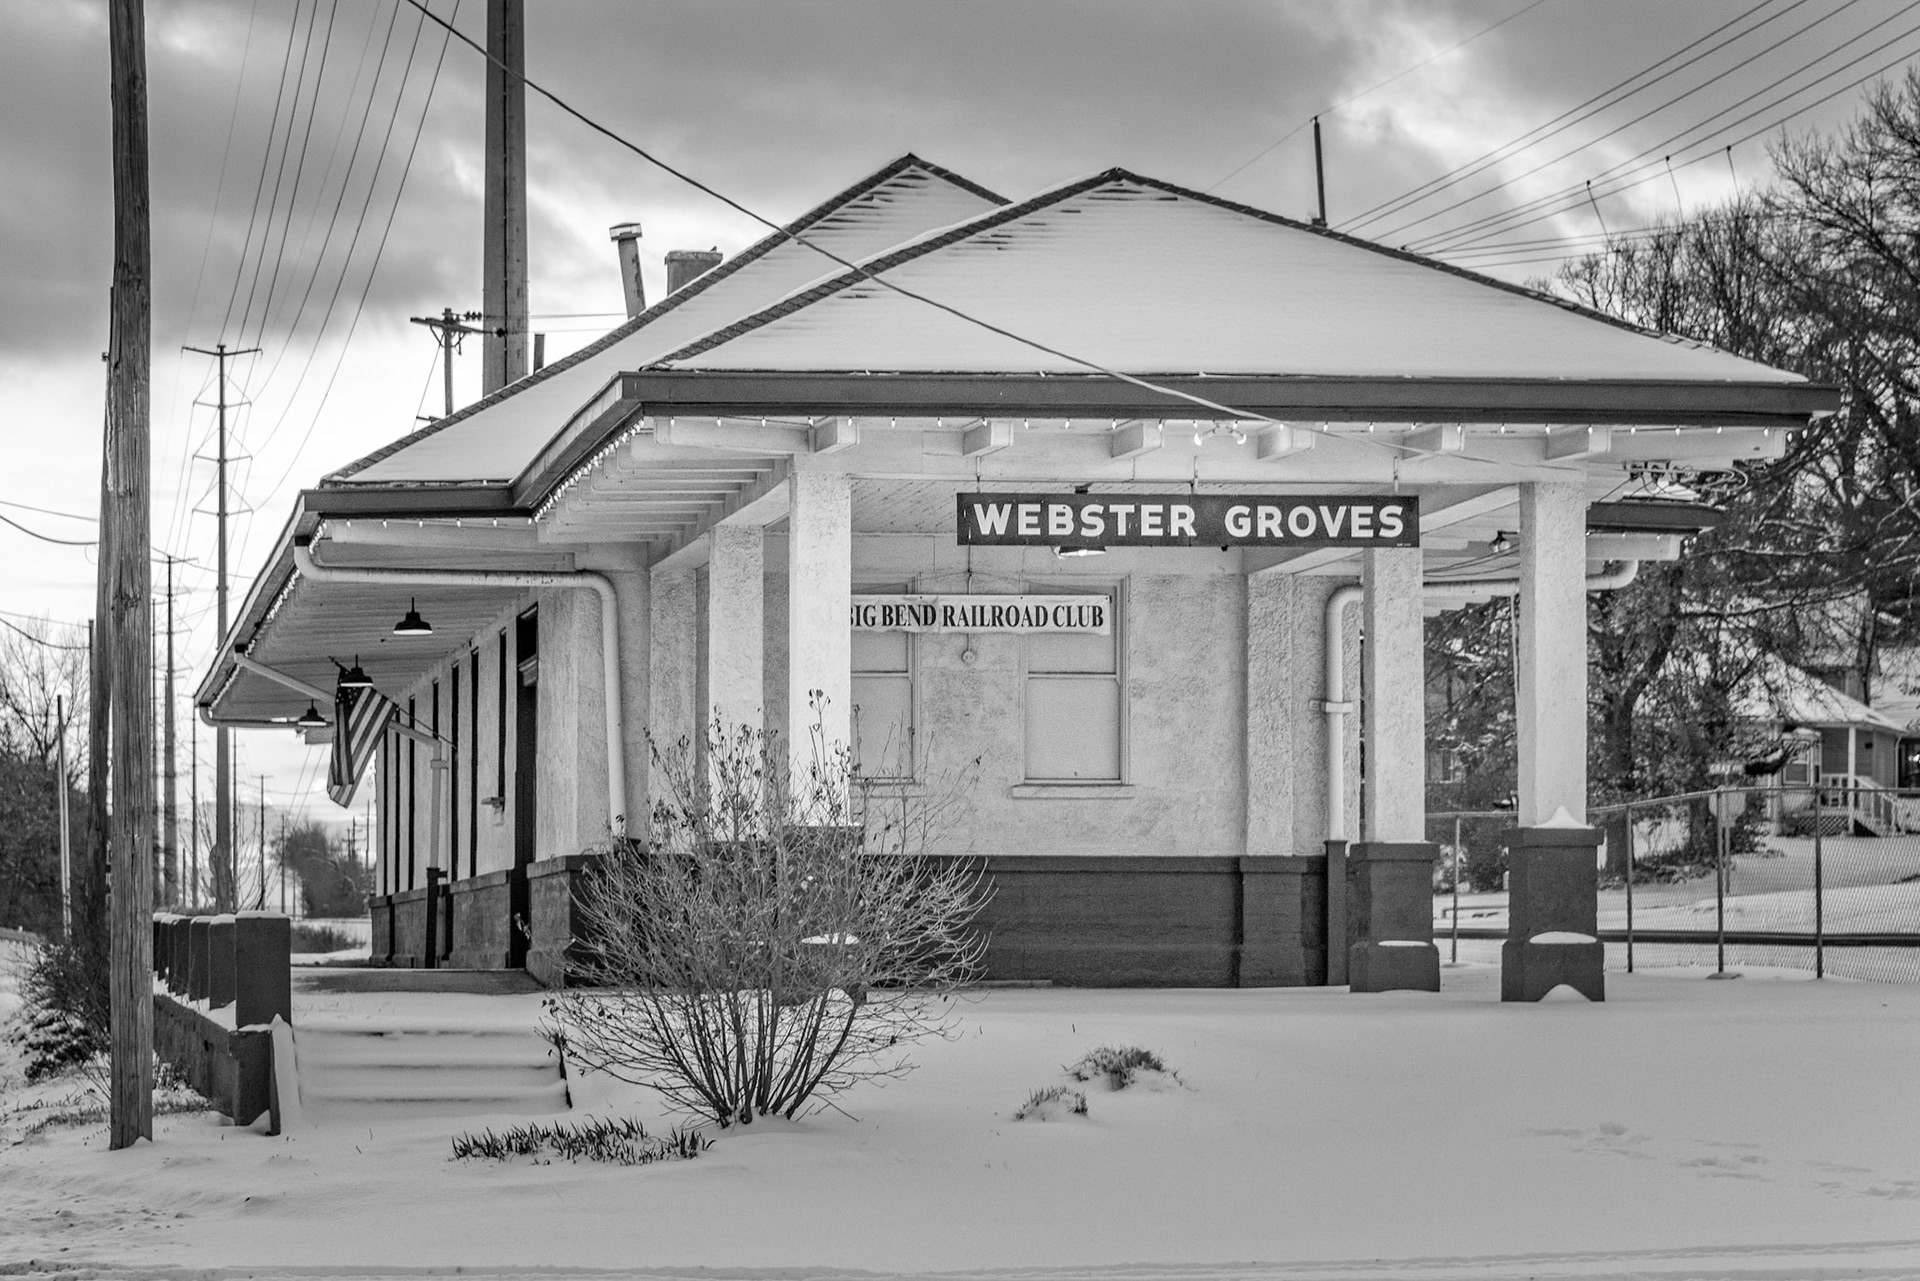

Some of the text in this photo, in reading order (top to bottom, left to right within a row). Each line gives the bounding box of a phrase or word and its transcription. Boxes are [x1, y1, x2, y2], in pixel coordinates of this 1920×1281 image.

[973, 503, 1404, 538] WEBSTER GROVES
[850, 604, 1104, 628] IG BEND RAILROAD CLUB
